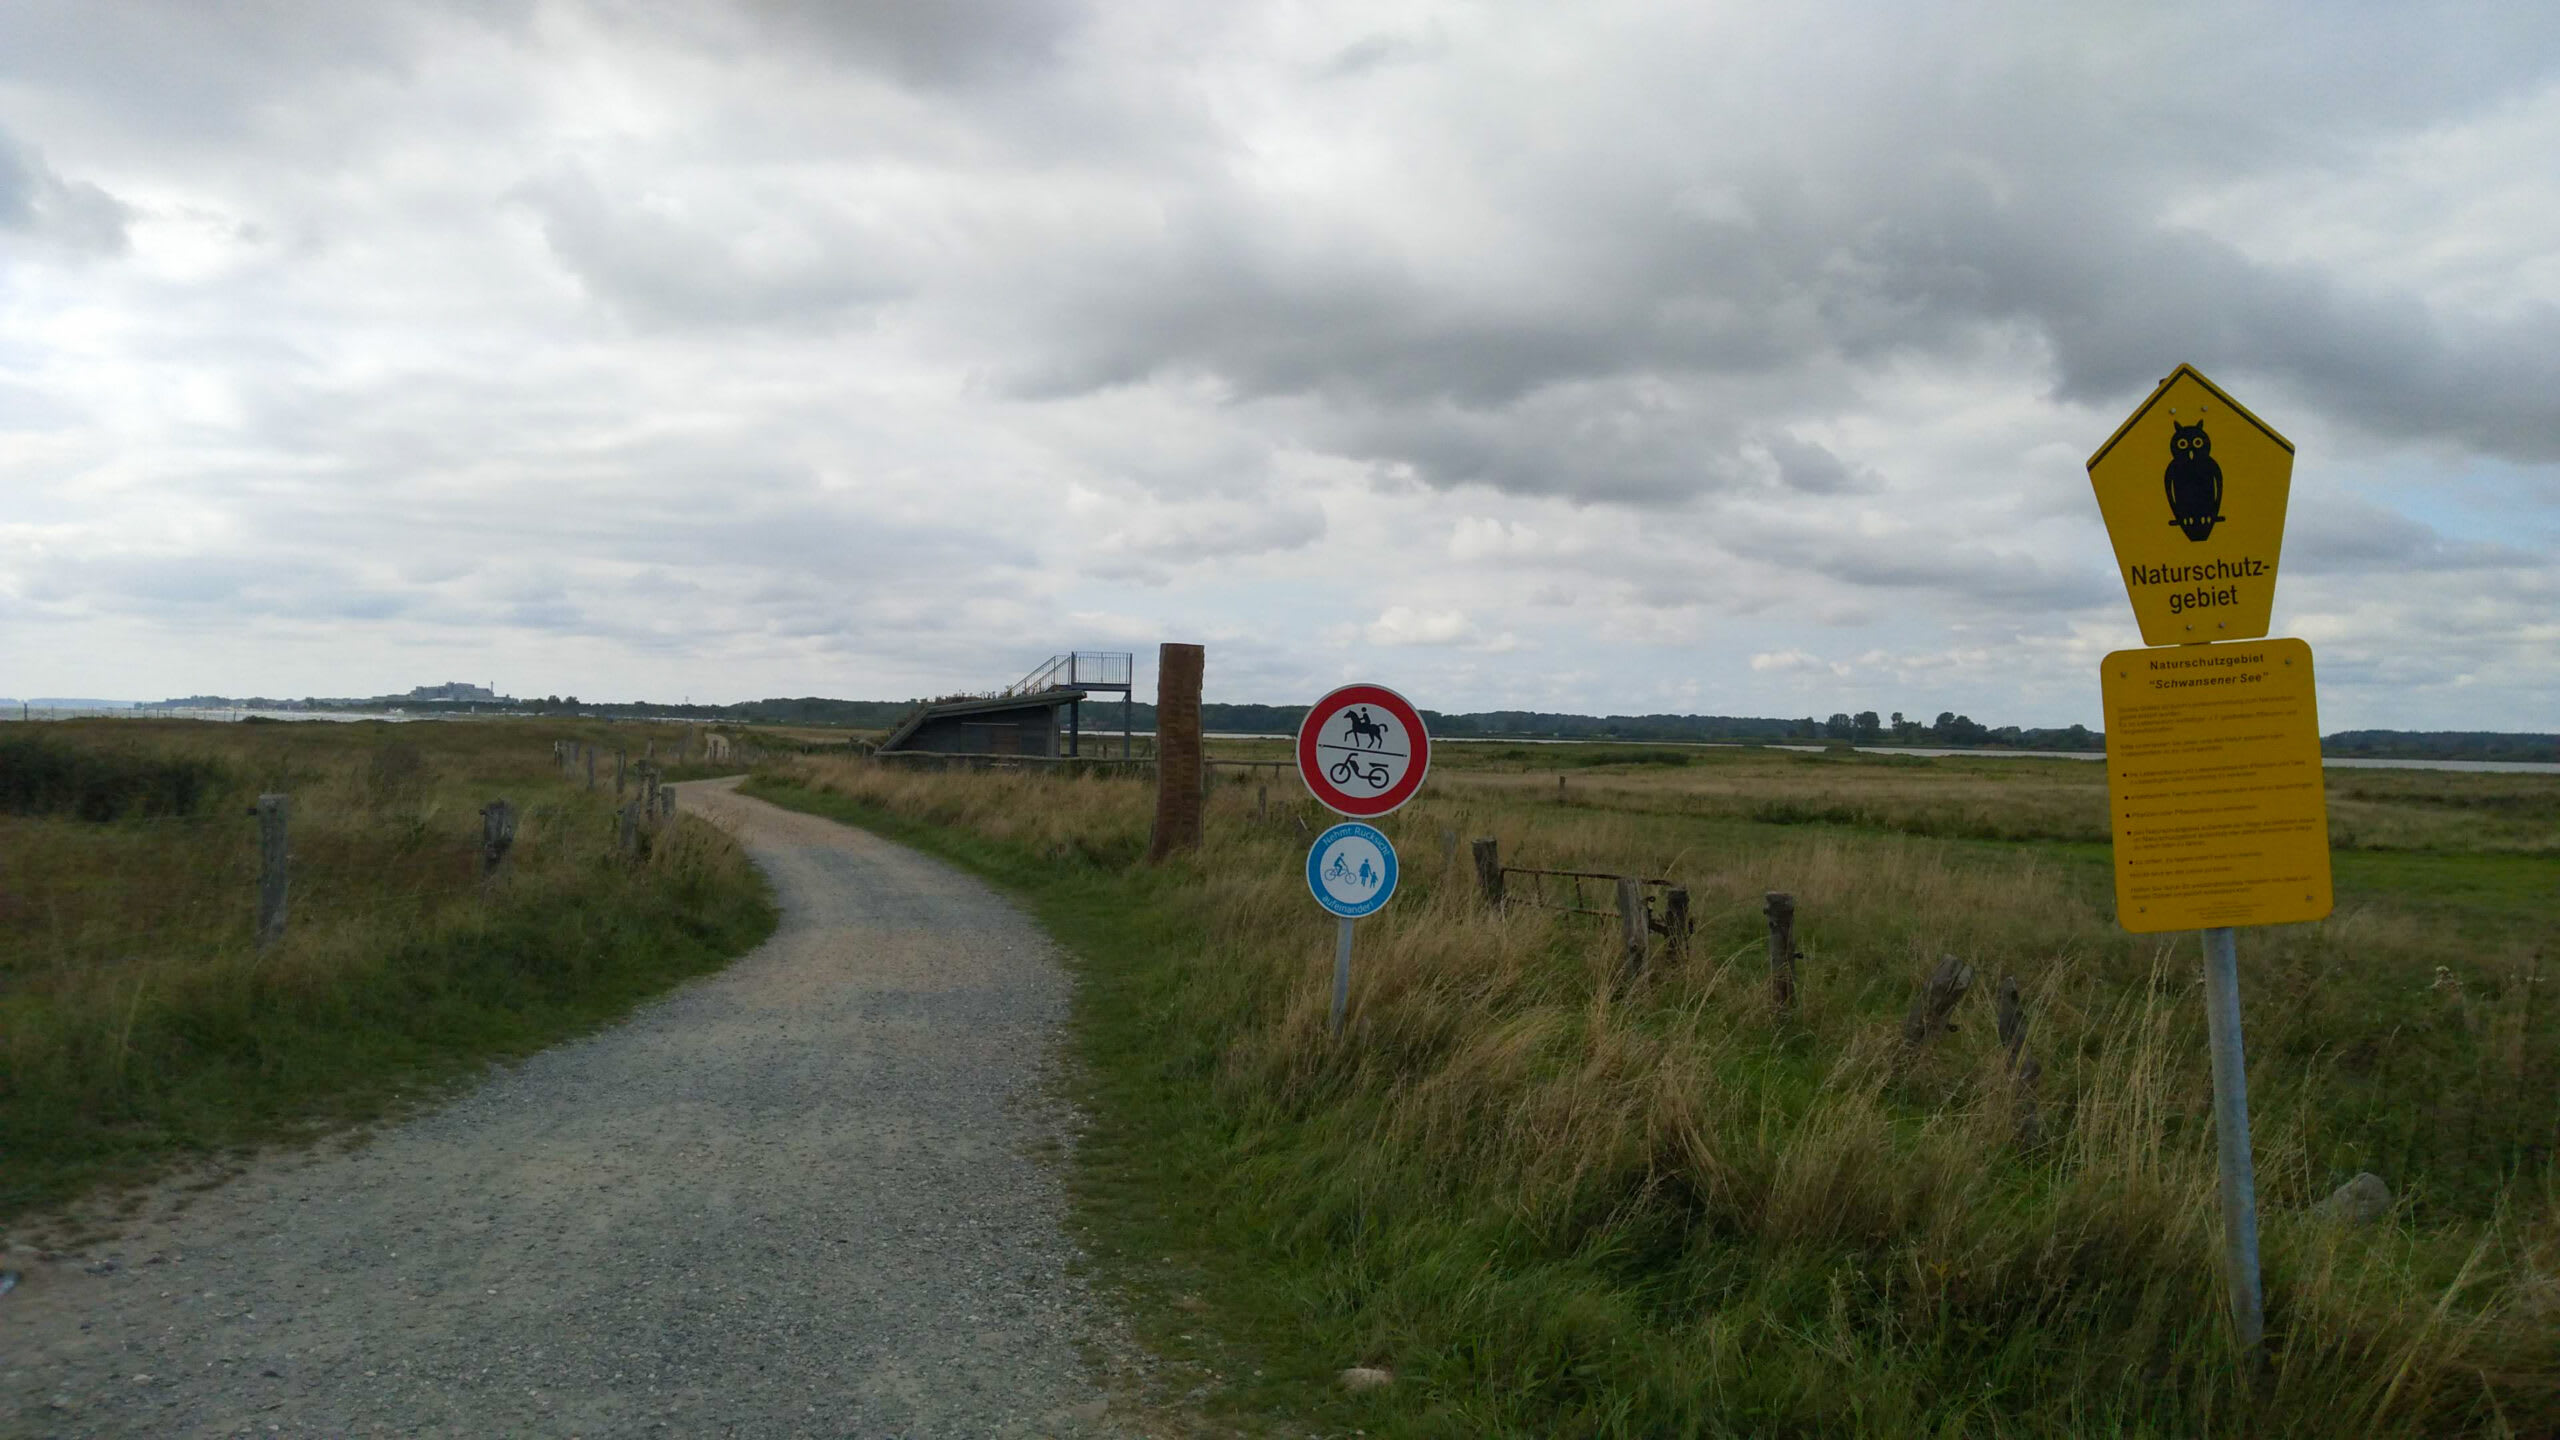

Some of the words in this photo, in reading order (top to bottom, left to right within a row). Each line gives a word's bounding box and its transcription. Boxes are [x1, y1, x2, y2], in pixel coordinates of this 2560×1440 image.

[2131, 556, 2270, 586] Naturschutz-
[2169, 585, 2238, 614] gebiet
[2149, 653, 2265, 671] Naturschutzgebiet
[1323, 828, 1352, 845] Nehmt
